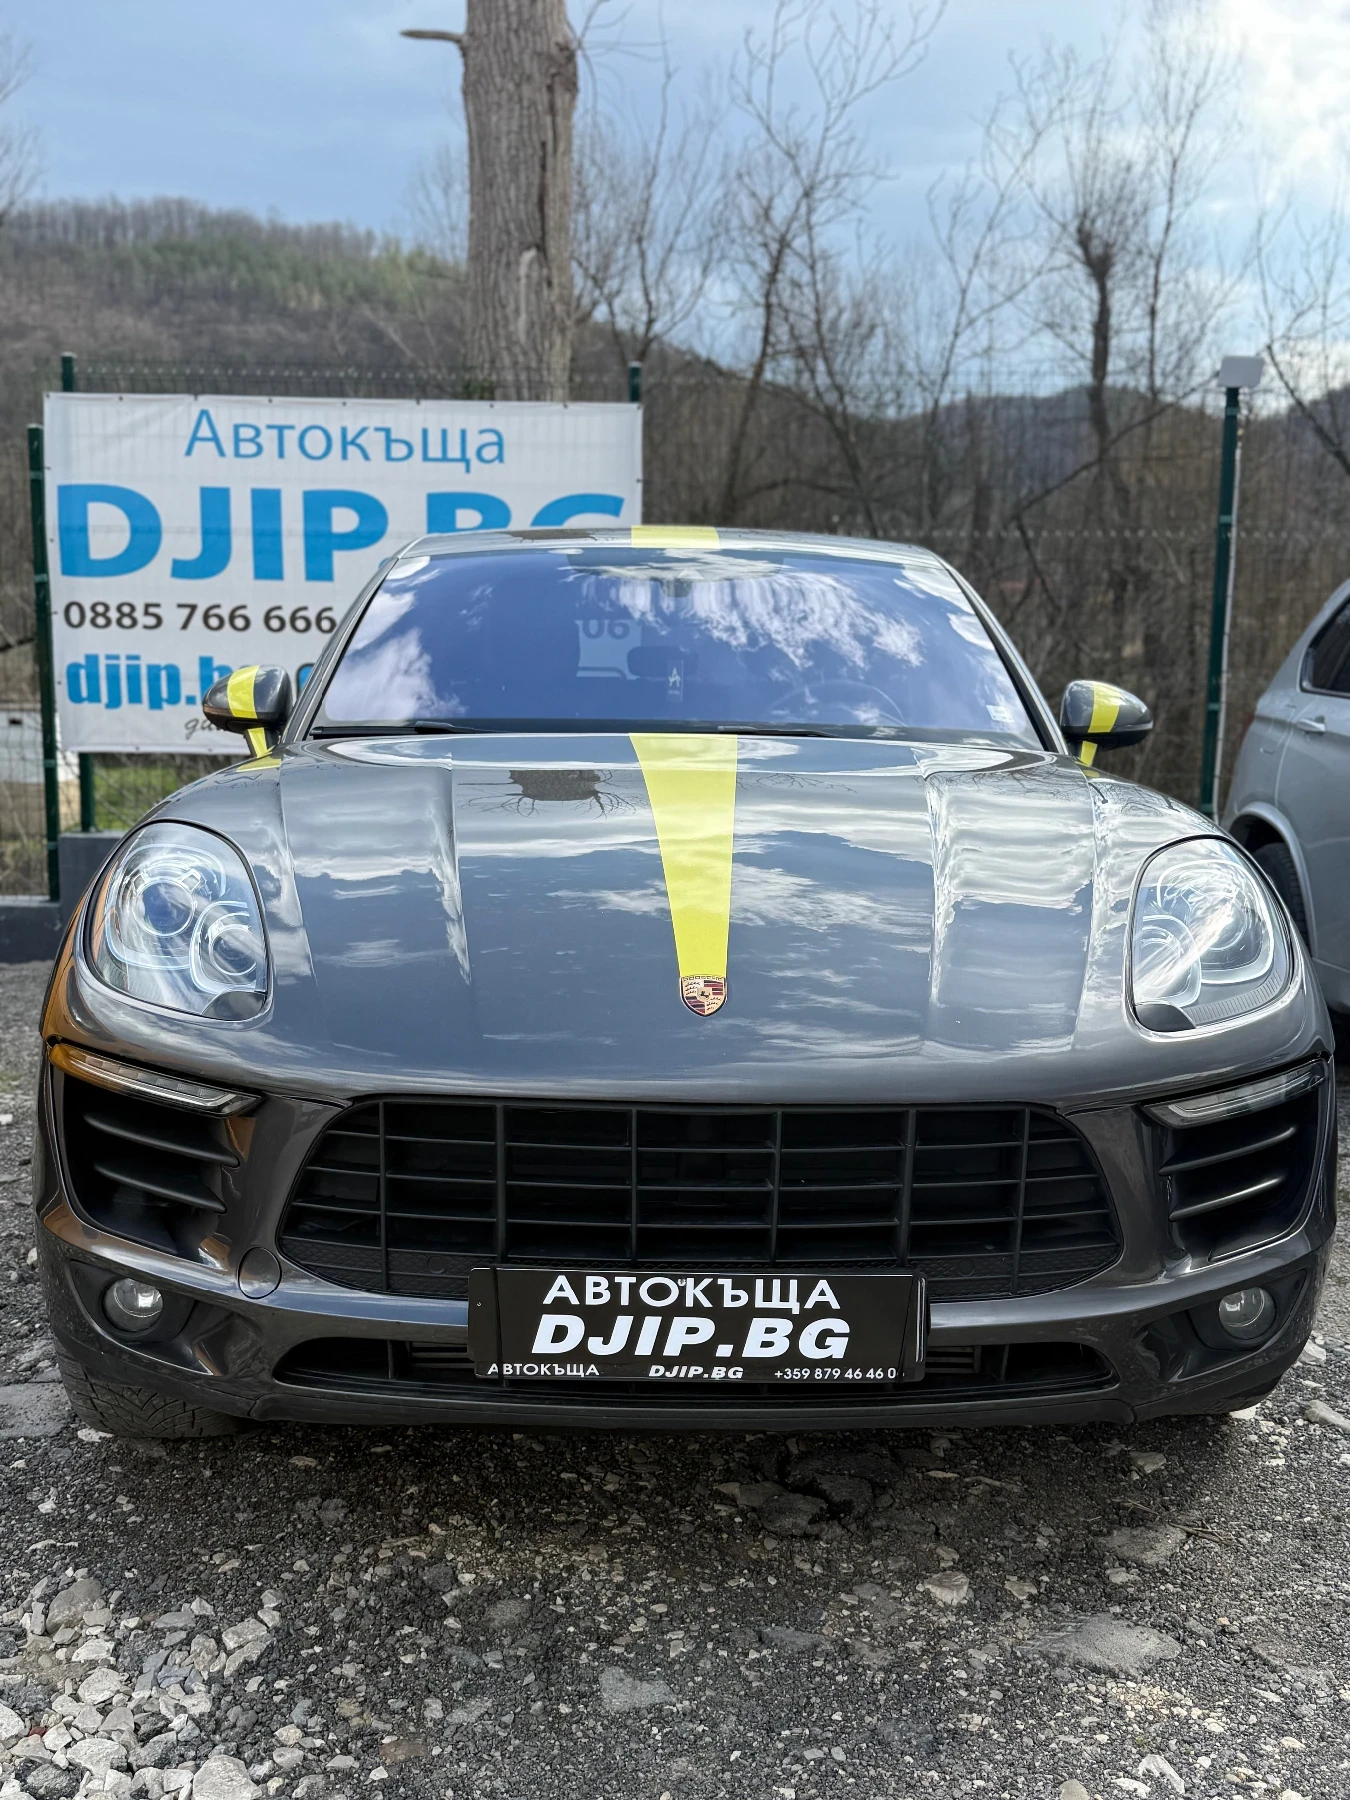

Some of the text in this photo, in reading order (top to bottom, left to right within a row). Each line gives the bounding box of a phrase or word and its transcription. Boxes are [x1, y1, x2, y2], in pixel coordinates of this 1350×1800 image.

[185, 409, 505, 474] Автокъща
[57, 484, 625, 582] DJIP
[64, 601, 337, 634] 0885 766 666
[542, 1275, 841, 1314] АВТОКЪЩА
[531, 1313, 851, 1359] DJIP.BG
[487, 1363, 600, 1378] АВТОКЪЩА
[648, 1365, 744, 1379] DJIP.BG
[774, 1367, 811, 1380] +359
[814, 1367, 841, 1380] 879
[844, 1367, 863, 1380] 46
[866, 1367, 884, 1380] 46
